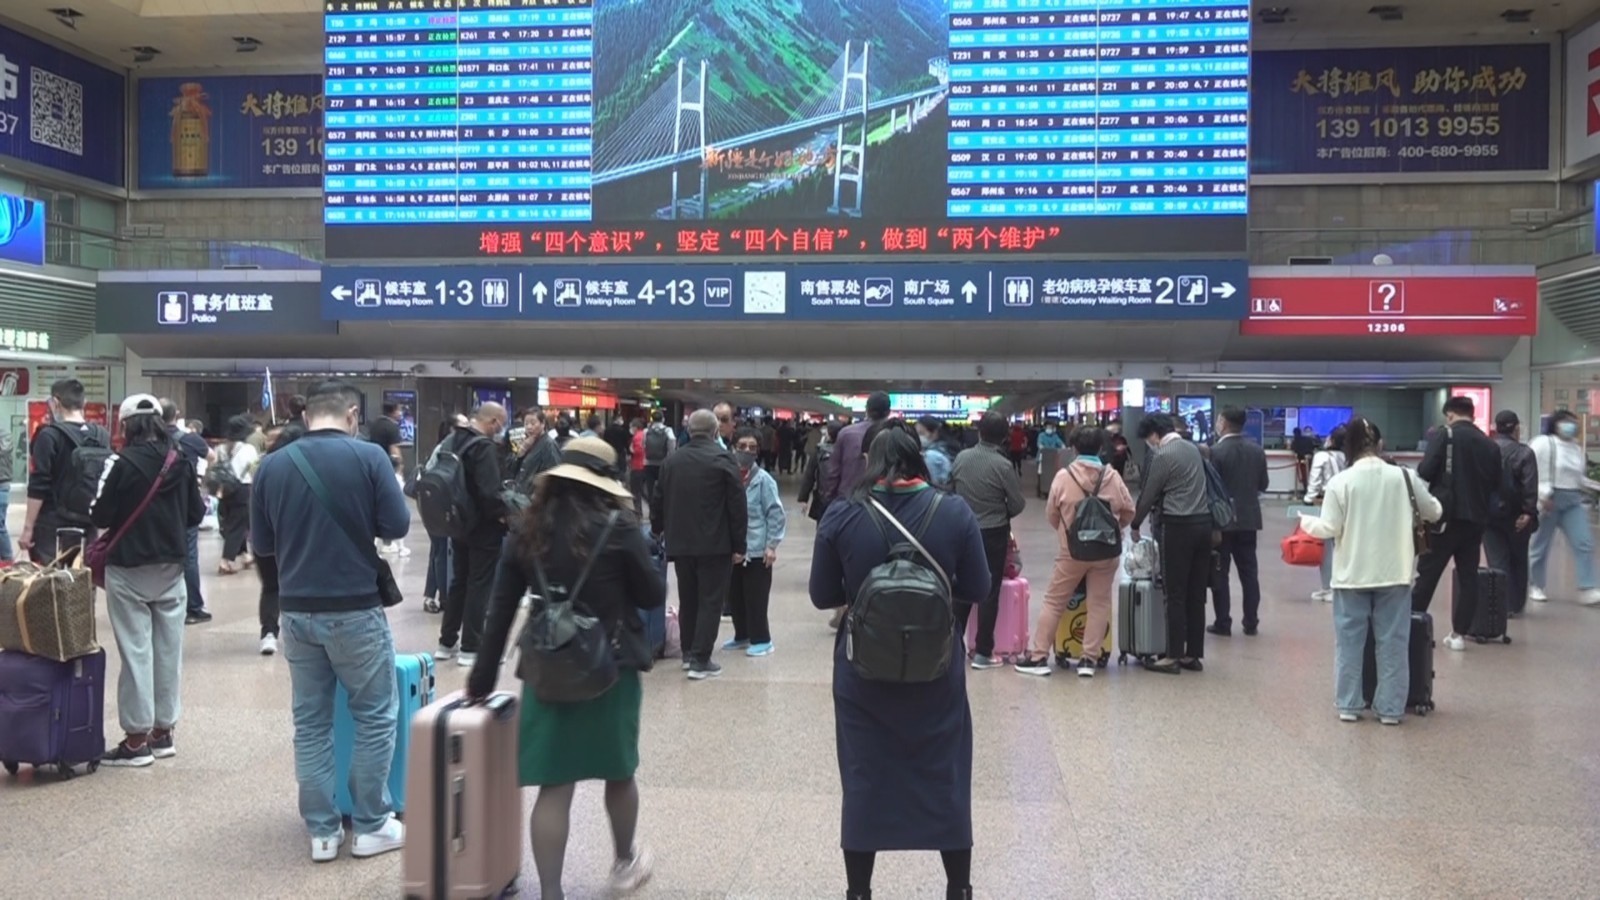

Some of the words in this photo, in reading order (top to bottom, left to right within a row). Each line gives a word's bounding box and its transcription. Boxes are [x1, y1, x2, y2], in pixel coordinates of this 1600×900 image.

[1064, 14, 1096, 24] 正在候车
[1215, 9, 1248, 19] 正在候车
[428, 32, 456, 41] 正在检票
[562, 28, 591, 37] 正在候车
[1063, 48, 1096, 58] 正在候车
[1214, 44, 1247, 54] 正在候车
[428, 65, 456, 74] 正在检票
[562, 61, 591, 70] 正在候车
[1063, 82, 1096, 92] 正在候车
[1214, 79, 1247, 89] 正在候车
[1292, 66, 1400, 98] 大将雄风
[1412, 66, 1527, 97] 助你成功
[427, 97, 456, 106] 正在检票
[561, 94, 591, 103] 正在候车
[1063, 117, 1095, 126] 正在候车
[1213, 114, 1247, 123] 正在候车
[561, 127, 591, 136] 正在候车
[1316, 118, 1360, 138] 139
[1370, 117, 1429, 138] 1013
[1437, 115, 1500, 136] 9955
[262, 138, 298, 156] 139
[1398, 145, 1499, 157] 400-680-9955
[1062, 151, 1095, 161] 正在候车
[1213, 148, 1247, 158] 正在候车
[427, 162, 456, 171] 正在候车
[561, 160, 590, 169] 正在候车
[1062, 185, 1094, 195] 正在候车
[1213, 183, 1246, 193] 正在候车
[427, 193, 456, 202] 正在候车
[561, 192, 590, 201] 正在候车
[384, 280, 427, 296] 候车室
[585, 280, 629, 296] 候车室
[637, 279, 696, 306] 4-13
[707, 286, 729, 298] VIP
[800, 279, 861, 296] 南售票处
[903, 280, 950, 296] 南广场
[1042, 278, 1152, 295] 老幼病残孕候车室
[1155, 277, 1175, 305] 2
[192, 293, 273, 312] 警务值班室
[384, 297, 411, 307] Waiting
[412, 297, 434, 306] Room
[585, 297, 612, 307] Waiting
[613, 297, 636, 306] Room
[811, 297, 834, 306] South
[835, 296, 861, 306] Tickets
[903, 297, 926, 306] South
[927, 297, 954, 307] Square
[1062, 295, 1097, 306] Courtesy
[1098, 295, 1127, 306] Waiting
[1128, 295, 1152, 305] Room
[191, 313, 217, 323] Police
[1367, 323, 1406, 333] 12306
